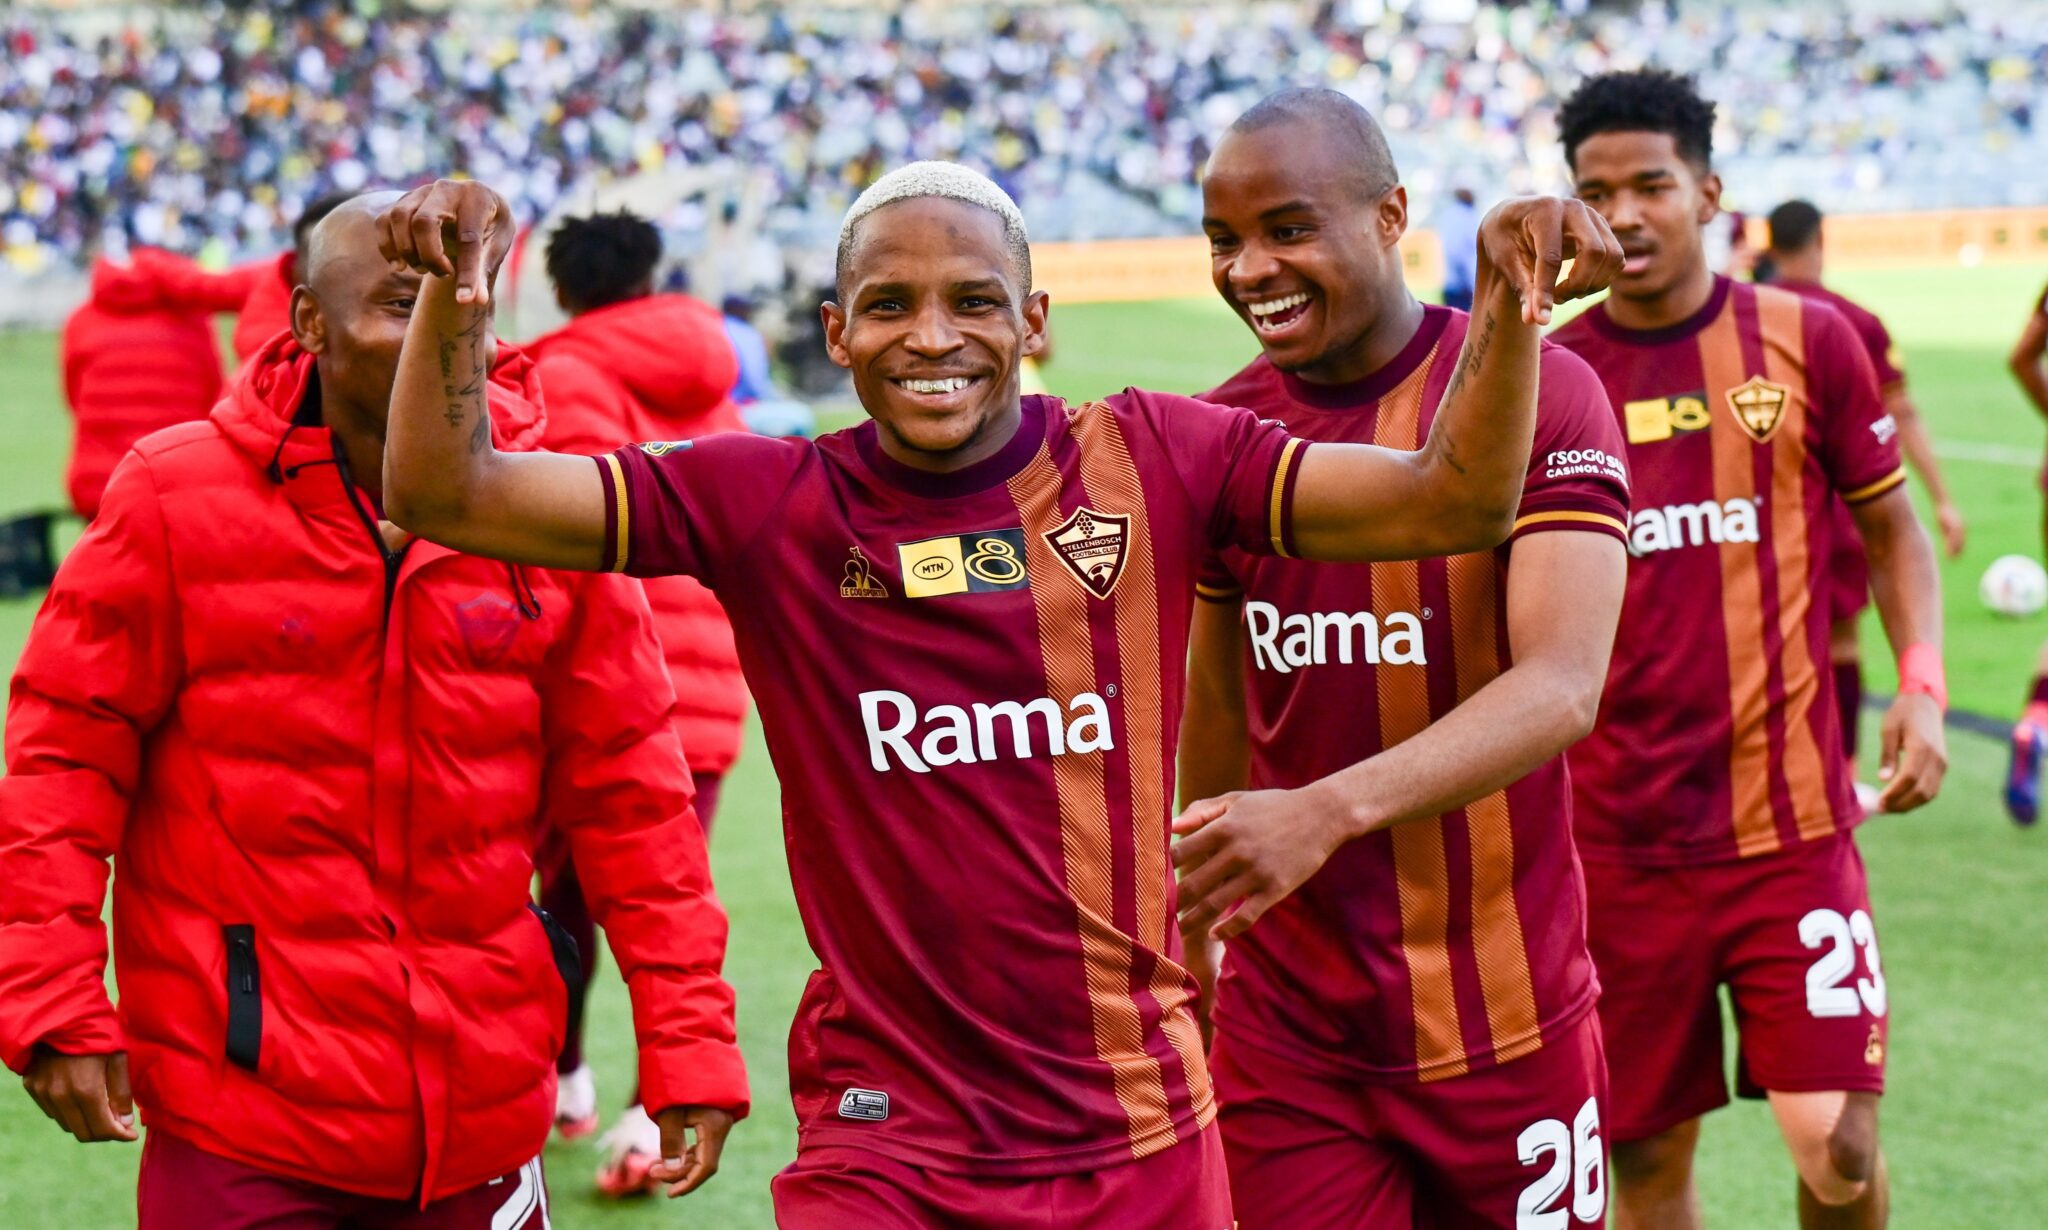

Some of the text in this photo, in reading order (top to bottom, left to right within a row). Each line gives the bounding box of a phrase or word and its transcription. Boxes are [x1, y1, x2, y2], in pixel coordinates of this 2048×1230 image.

[1546, 464, 1599, 479] CASINOS
[1627, 498, 1760, 558] ama
[1062, 536, 1122, 552] STELLENBOSCH
[1072, 549, 1102, 558] FOOTBALL
[922, 562, 944, 574] MTN
[965, 538, 1025, 584] 8
[1798, 909, 1886, 1018] 23
[1516, 1096, 1605, 1230] 26
